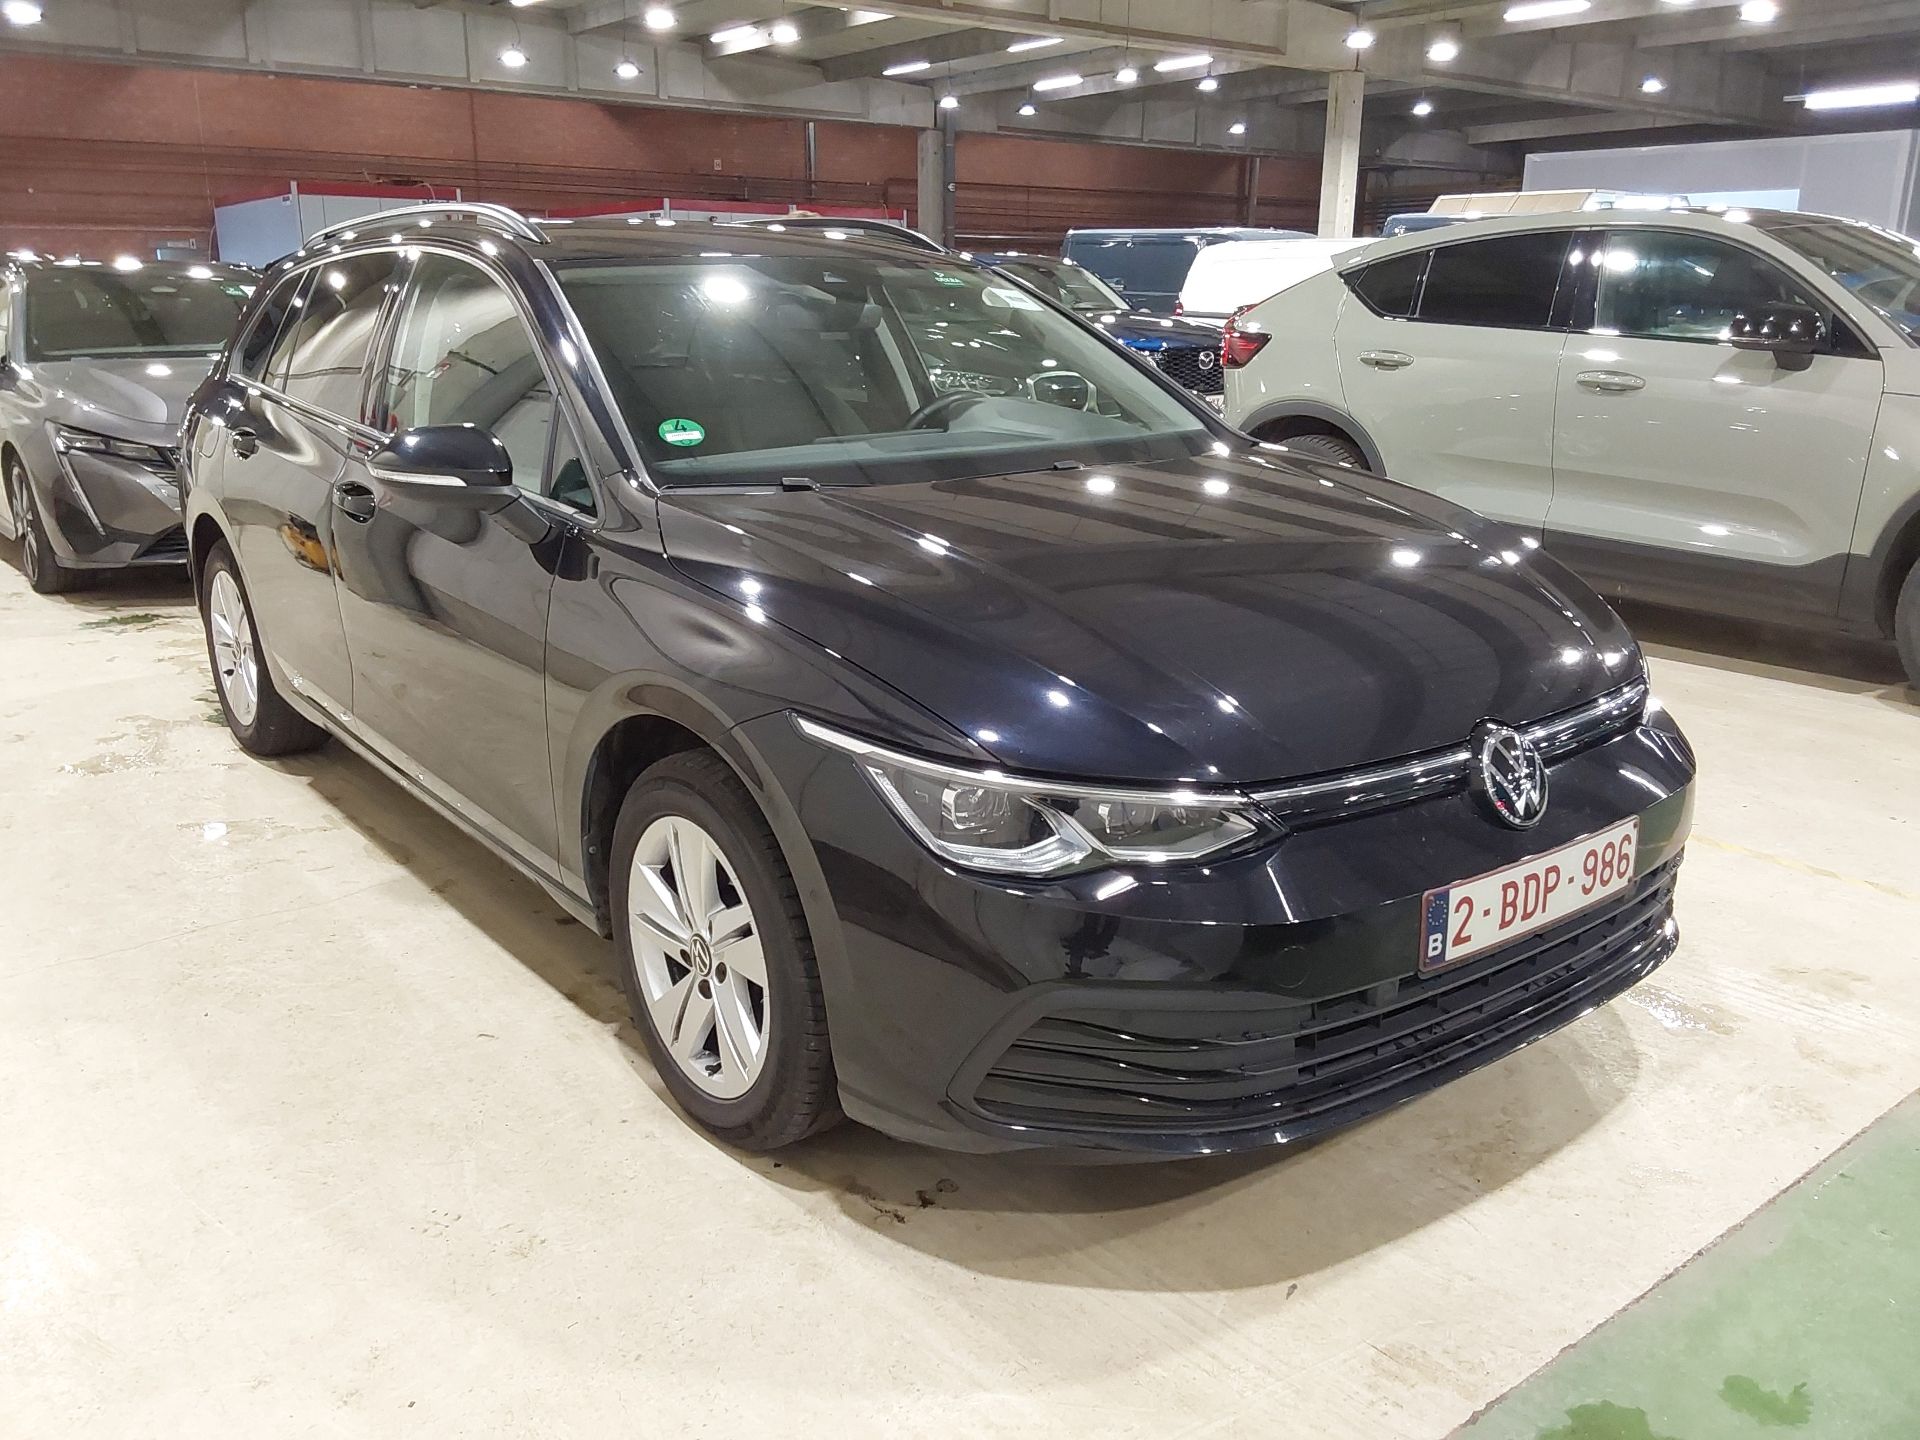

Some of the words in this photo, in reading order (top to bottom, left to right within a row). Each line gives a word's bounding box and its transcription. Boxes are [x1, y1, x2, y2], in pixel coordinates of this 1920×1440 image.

[675, 419, 688, 432] 4
[1451, 833, 1632, 947] 2-BDP-986
[1427, 932, 1443, 957] B
